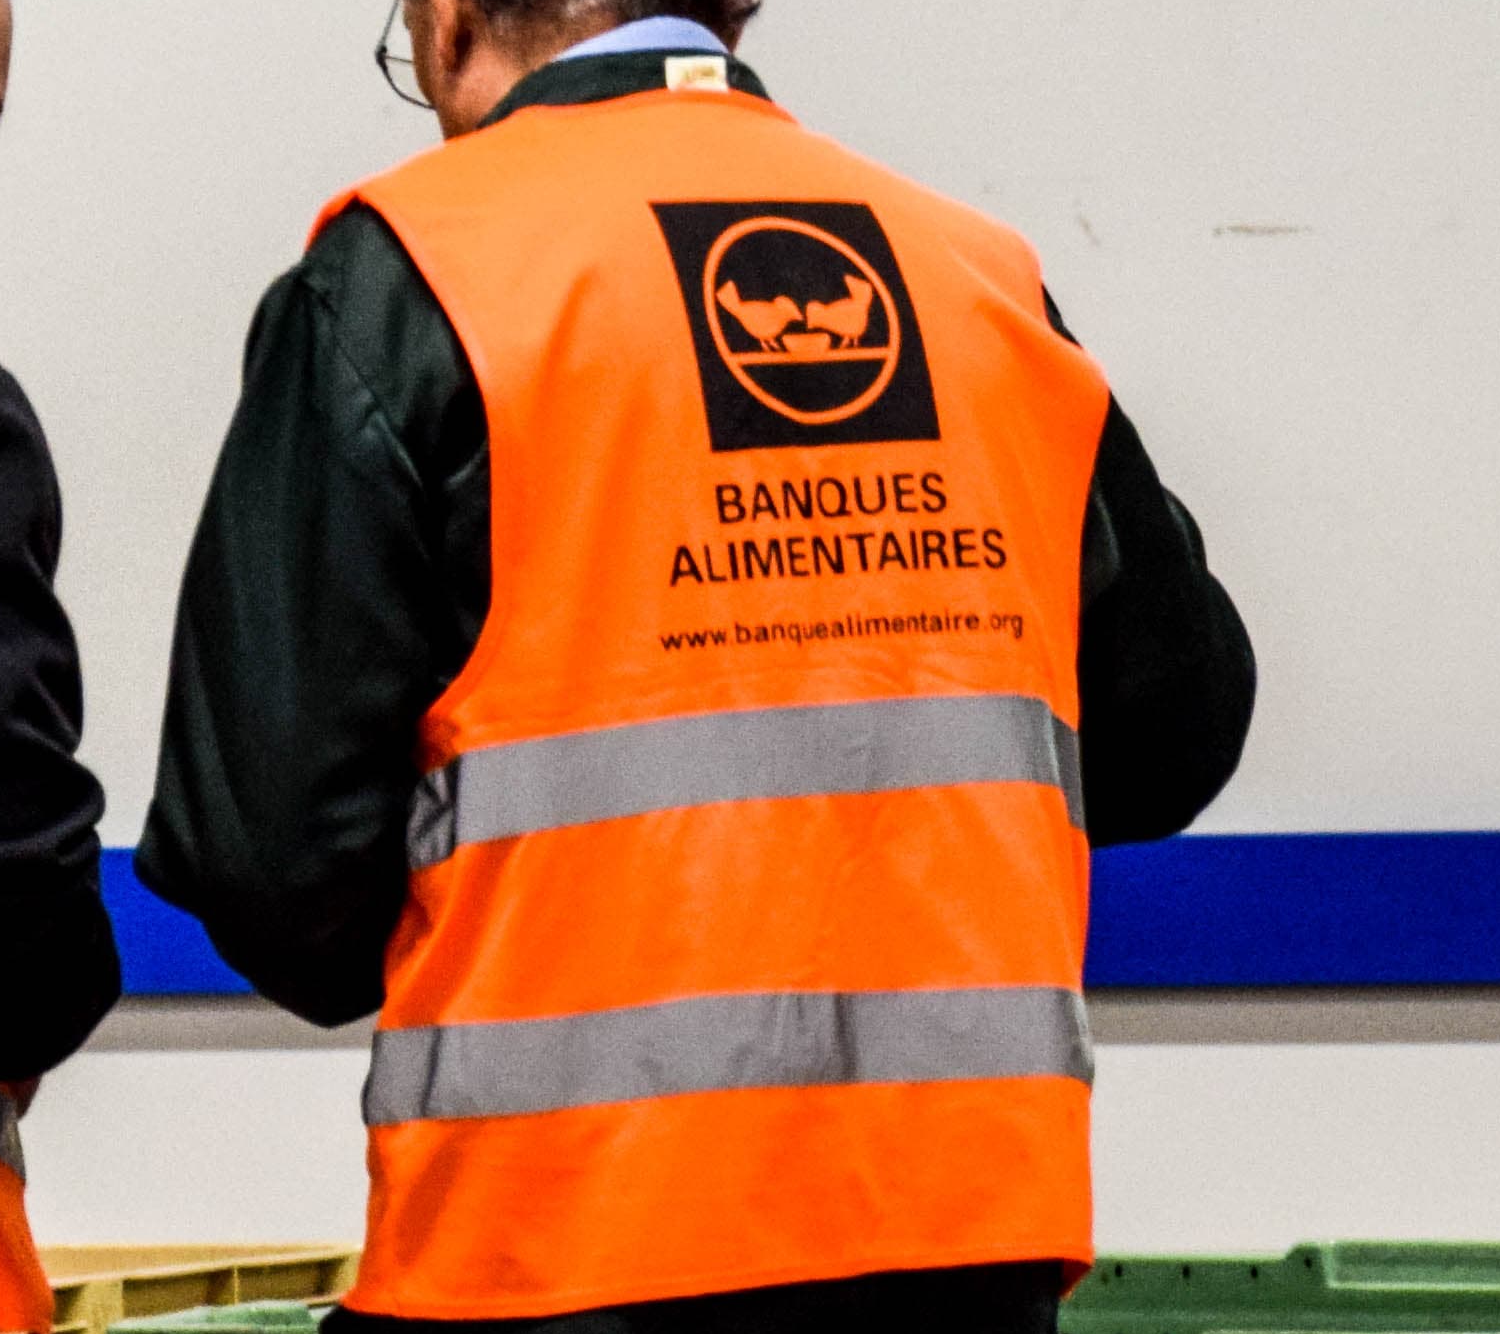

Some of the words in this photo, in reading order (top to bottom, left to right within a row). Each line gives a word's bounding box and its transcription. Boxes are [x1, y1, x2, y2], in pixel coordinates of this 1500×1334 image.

[714, 472, 948, 525] BANQUES
[669, 527, 1008, 588] ALIMENTAIRES
[659, 609, 1025, 651] www.banquealimentaire.org
